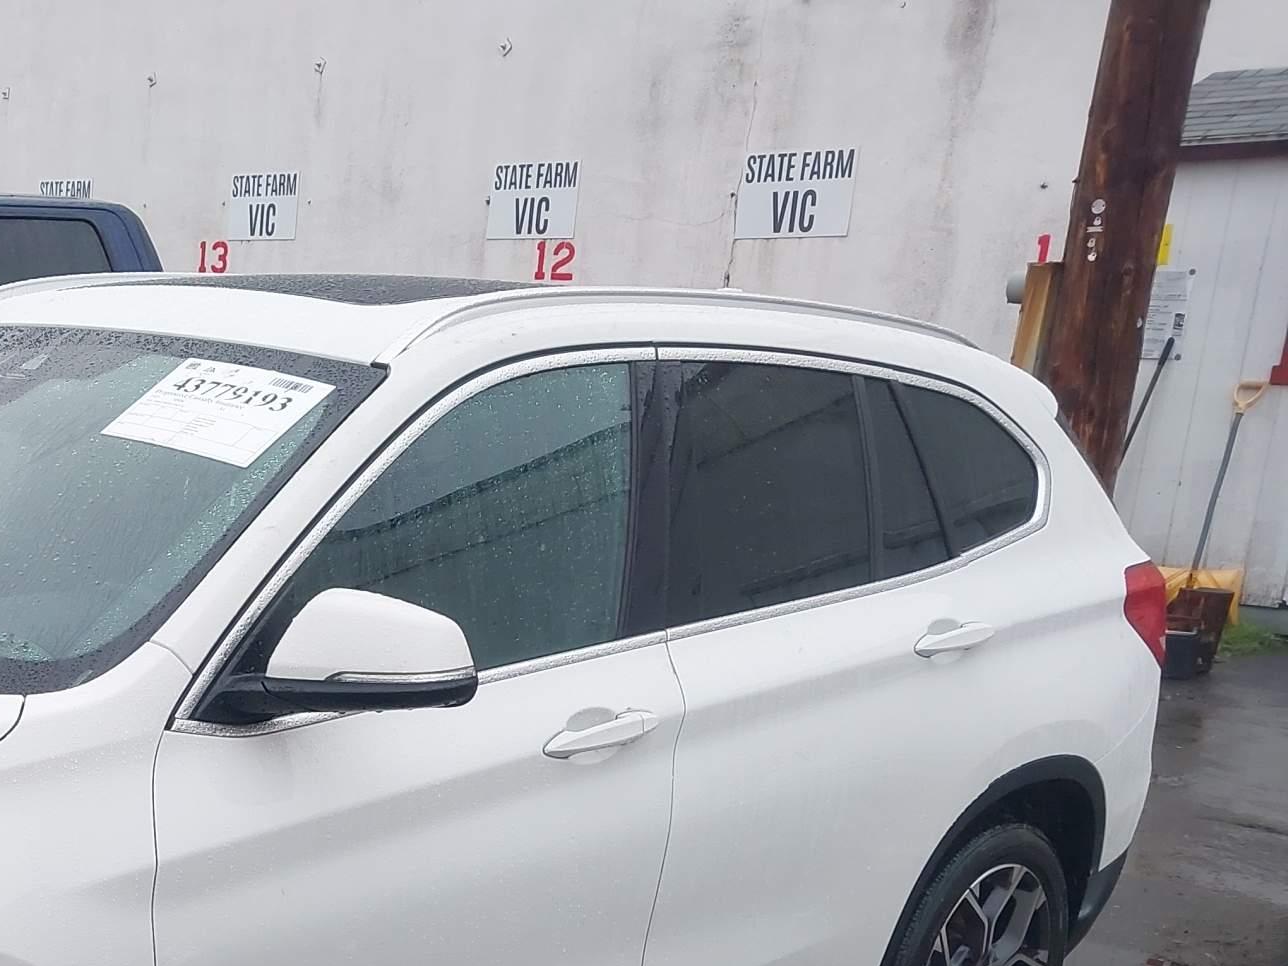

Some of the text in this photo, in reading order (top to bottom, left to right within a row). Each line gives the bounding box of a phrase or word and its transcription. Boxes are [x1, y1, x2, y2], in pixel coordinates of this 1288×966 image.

[494, 161, 579, 190] STATE FARM
[745, 148, 855, 183] STATE FARM
[39, 180, 91, 199] STATE FARM
[232, 173, 297, 197] STATE FARM
[249, 203, 276, 236] VIC
[515, 196, 550, 235] VIC
[772, 189, 817, 233] VIC
[198, 241, 229, 273] 13
[534, 241, 575, 280] 12
[173, 376, 293, 412] 43779193
